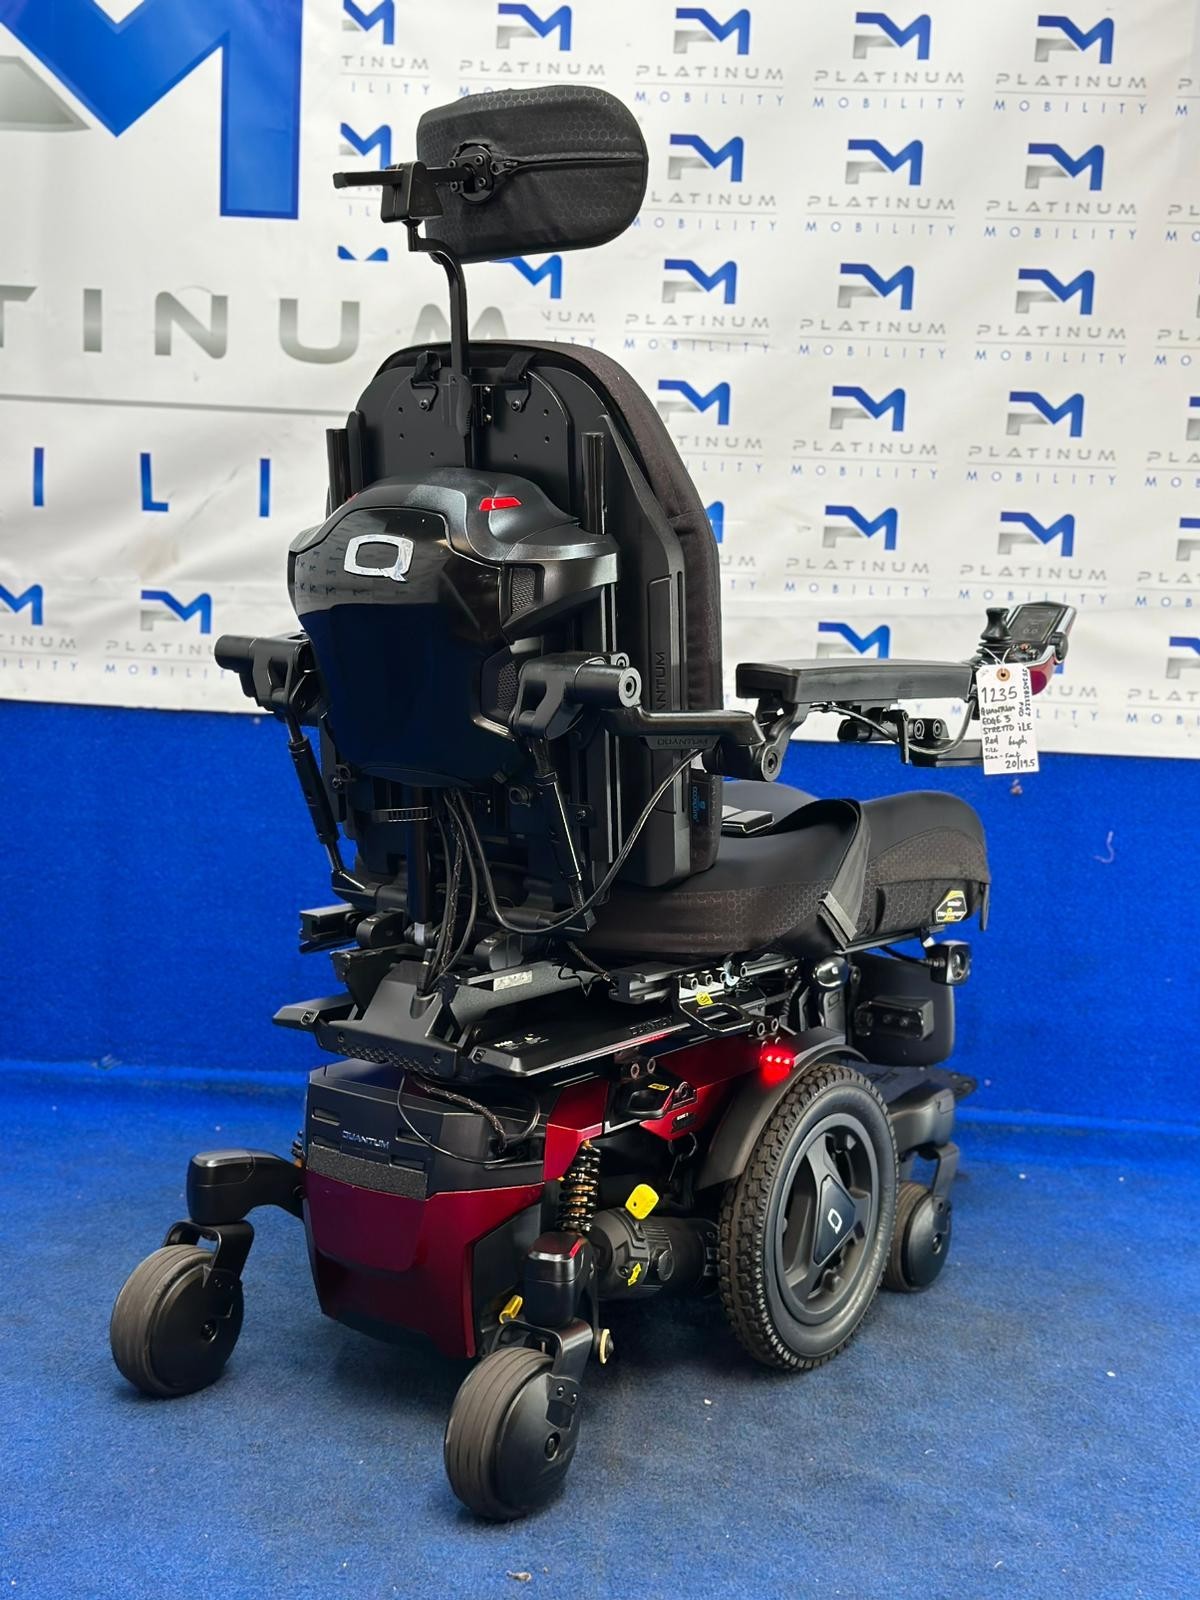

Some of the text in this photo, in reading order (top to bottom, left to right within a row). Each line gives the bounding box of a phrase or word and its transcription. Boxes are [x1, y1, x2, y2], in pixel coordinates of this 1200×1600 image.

[459, 60, 605, 75] PLATINUM
[636, 65, 783, 80] PLATINUM
[814, 70, 964, 83] PLATINUM
[996, 73, 1147, 89] PLATINUM
[634, 91, 783, 106] MOBILITY
[813, 97, 964, 109] MOBILITY
[993, 102, 1147, 115] MOBILITY
[652, 192, 777, 206] LATINUM
[807, 196, 955, 210] PLATINUM
[986, 200, 1136, 215] PLATINUM
[805, 221, 954, 235] MOBILITY
[984, 226, 1136, 240] MOBILITY
[625, 314, 769, 328] PLATINUM
[800, 319, 946, 335] PLATINUM
[977, 324, 1126, 339] PLATINUM
[624, 339, 770, 354] MOBILITY
[798, 344, 945, 359] MOBILITY
[975, 350, 1126, 364] MOBILITY
[793, 440, 937, 455] PLATINUM
[968, 446, 1116, 461] PLATINUM
[791, 465, 937, 479] MOBILITY
[966, 471, 1116, 485] MOBILITY
[344, 534, 414, 582] Q
[786, 558, 929, 573] PLATINUM
[960, 565, 1107, 580] PLATINUM
[1137, 571, 1200, 584] PLA
[784, 582, 930, 597] MOBILITY
[959, 589, 1106, 604] MOBILITY
[0, 634, 77, 649] INUM
[981, 686, 1017, 703] 1235
[982, 714, 1011, 725] EDGE 3
[342, 1130, 390, 1149] QUANTUM
[828, 1208, 843, 1234] Q
